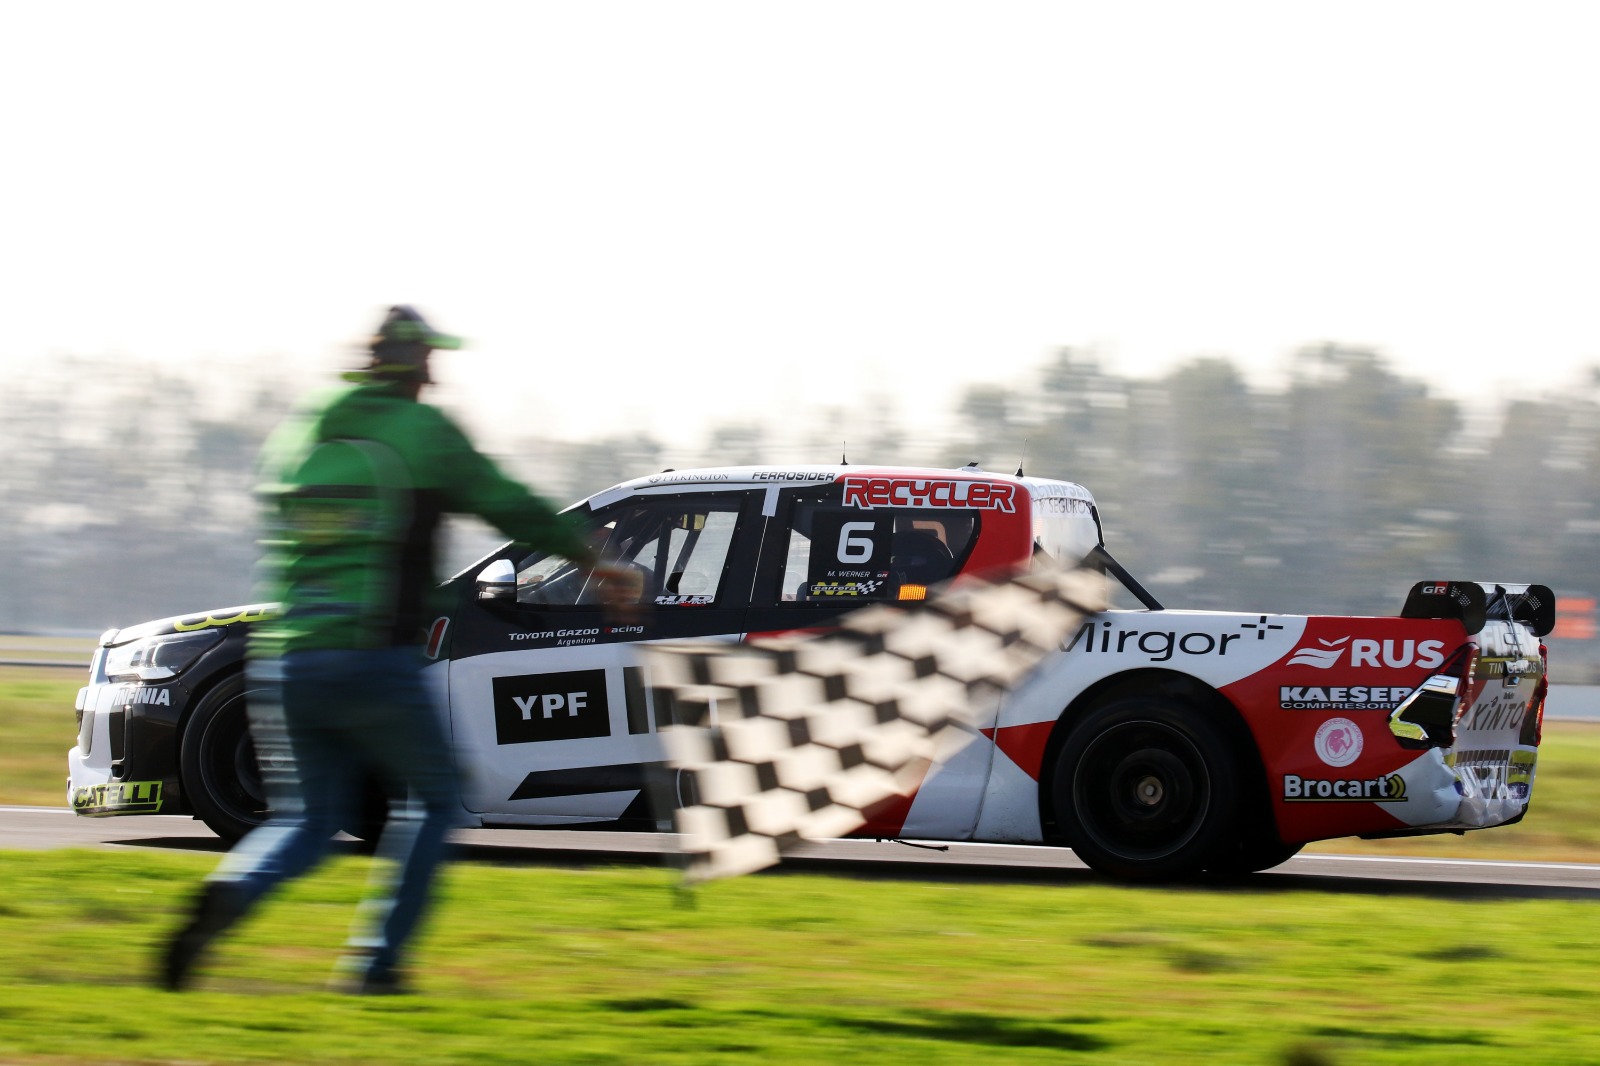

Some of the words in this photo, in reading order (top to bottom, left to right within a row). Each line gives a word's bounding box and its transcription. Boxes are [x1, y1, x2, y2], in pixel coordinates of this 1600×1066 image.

[752, 472, 835, 481] FERROSIDER
[844, 478, 1015, 512] RECYCLER
[836, 521, 876, 564] 6
[1423, 586, 1447, 594] GR
[509, 631, 554, 640] TOYOTA
[557, 628, 600, 637] GAZOO
[557, 638, 596, 646] Argentina
[1351, 639, 1445, 669] RUS
[113, 687, 170, 706] INFINIA
[512, 692, 588, 720] YPF
[1284, 775, 1388, 797] Brocart
